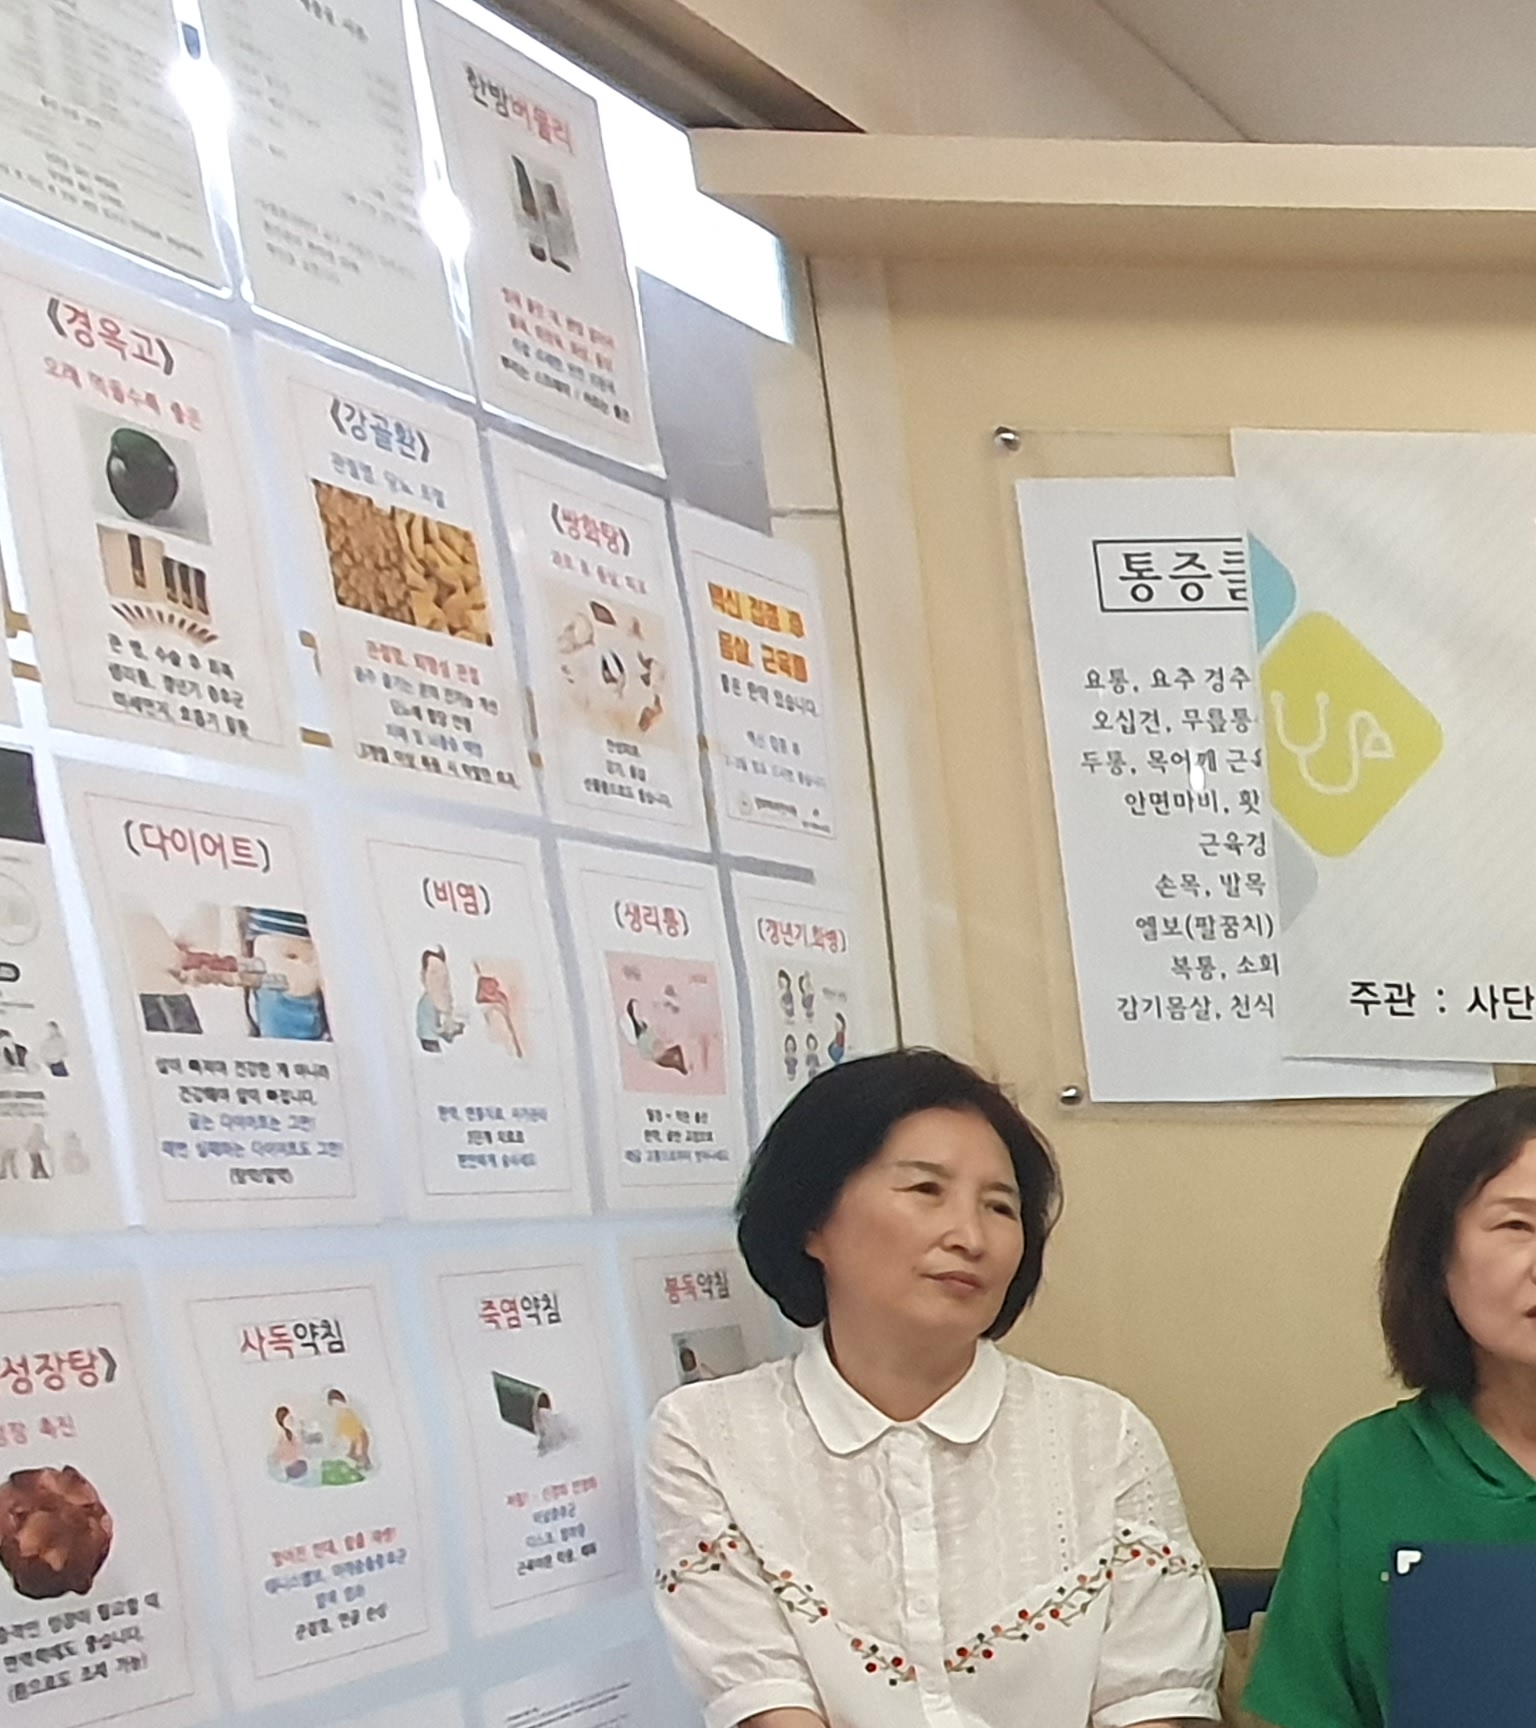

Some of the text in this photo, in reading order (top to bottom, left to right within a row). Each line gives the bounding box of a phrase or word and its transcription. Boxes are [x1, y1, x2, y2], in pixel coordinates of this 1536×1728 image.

[1084, 667, 1139, 695] 요통,
[1091, 708, 1256, 735] 오십견, 무릎통
[1080, 749, 1137, 776] 두통,
[1147, 749, 1218, 775] 목어깨
[1124, 789, 1230, 816] 안면마비,
[124, 818, 271, 874] (다이어트)
[1198, 831, 1267, 857] 근육경
[421, 876, 492, 917] (비염)
[1154, 871, 1267, 899] 손목, 발목
[613, 900, 690, 937] (생리통)
[1135, 913, 1274, 942] 엘보(팔꿈치)
[1170, 954, 1227, 980] 복통,
[1116, 992, 1275, 1022] 감기몸살, 천식
[1348, 979, 1418, 1018] 주관
[478, 1293, 562, 1331] 죽염약침
[240, 1318, 346, 1361] 사독약침
